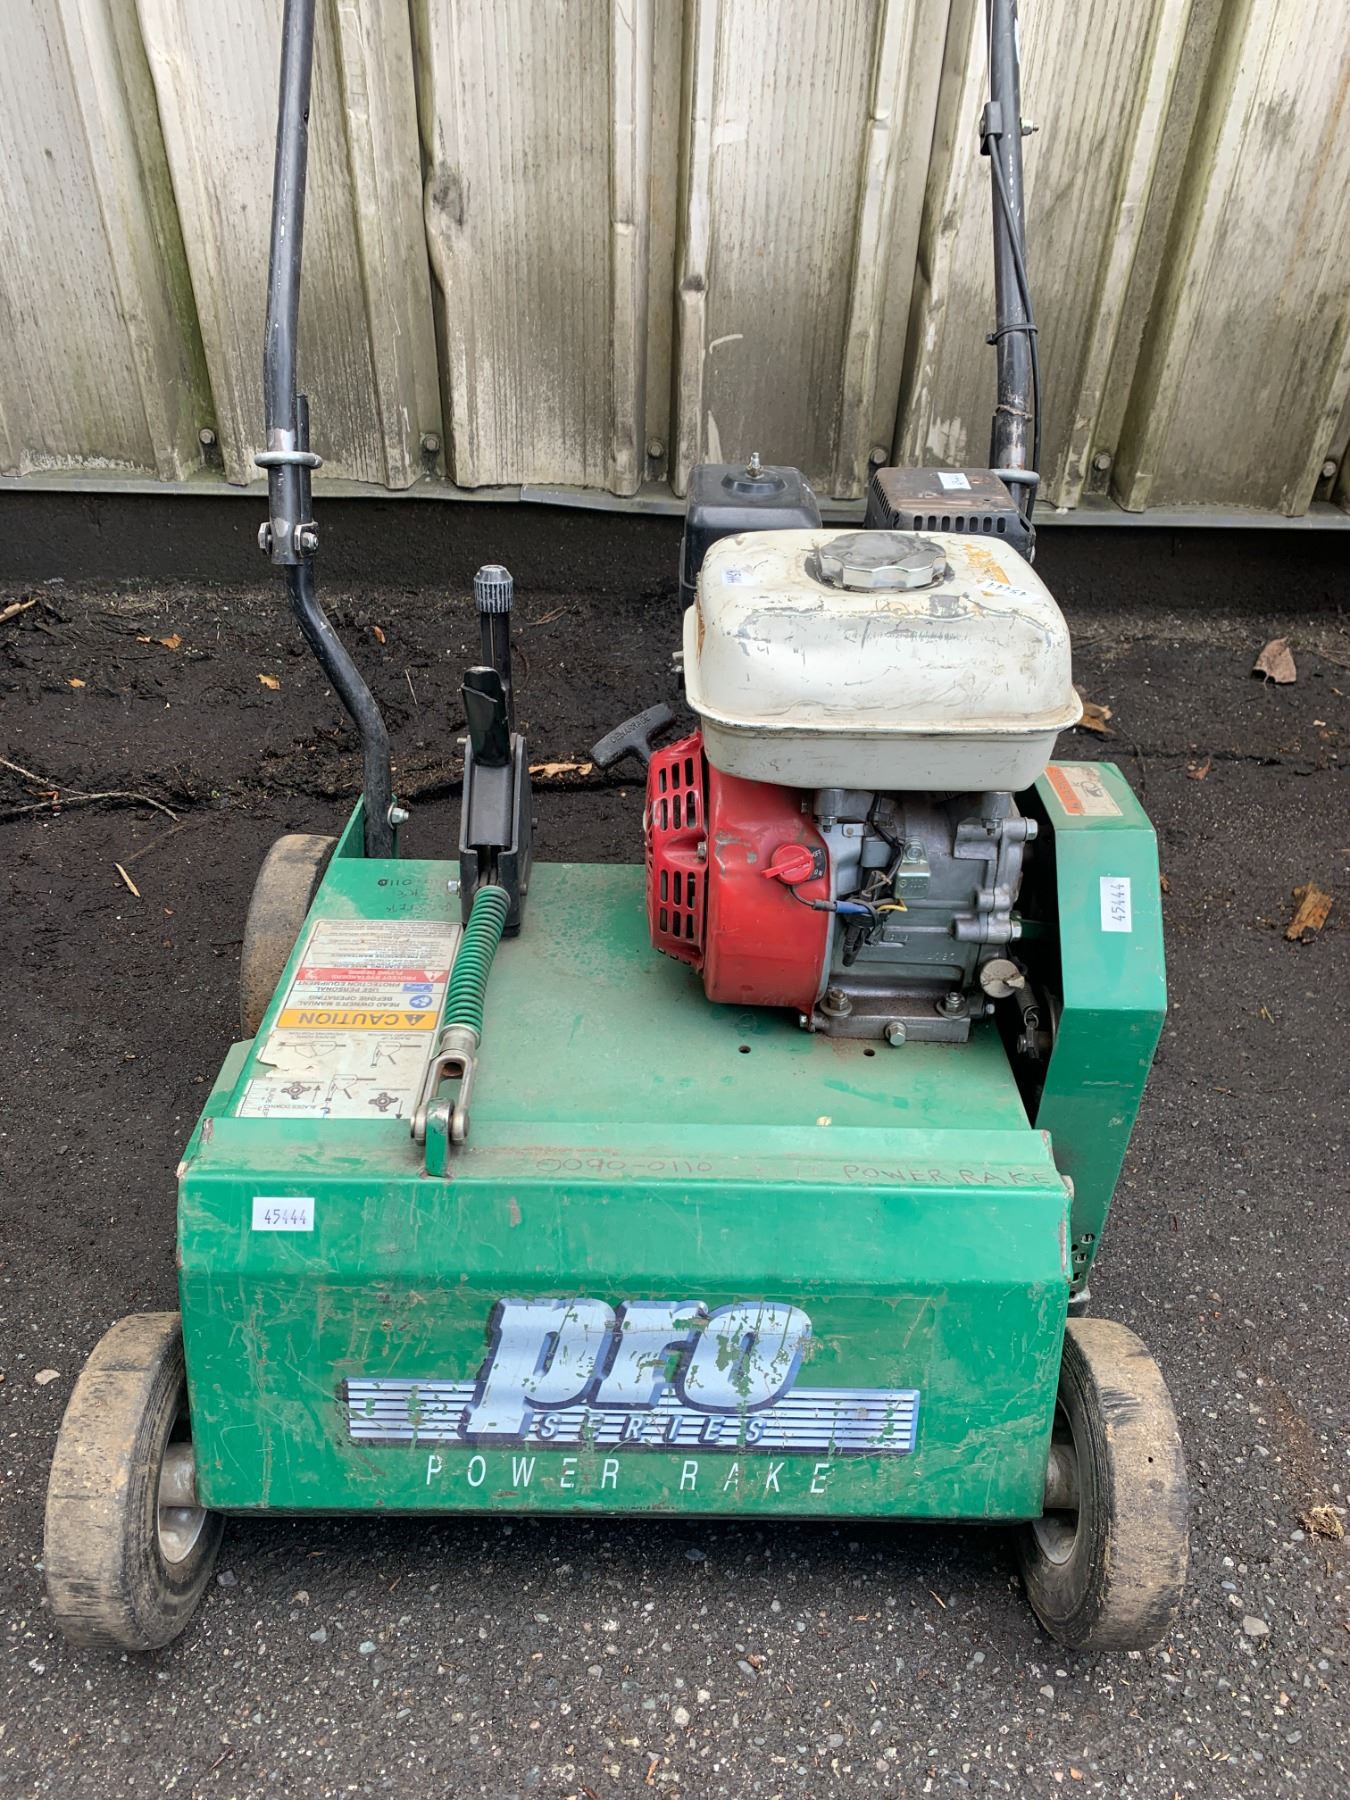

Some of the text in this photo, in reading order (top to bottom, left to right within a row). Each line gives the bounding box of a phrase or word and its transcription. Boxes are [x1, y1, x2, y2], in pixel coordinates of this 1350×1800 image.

[1110, 883, 1126, 922] 45444
[299, 1012, 399, 1025] CAUTION
[844, 1164, 1051, 1185] POWER RAKE
[264, 1207, 307, 1226] 45444
[536, 1413, 767, 1444] SERIES
[427, 1455, 831, 1494] POWER RAKE
